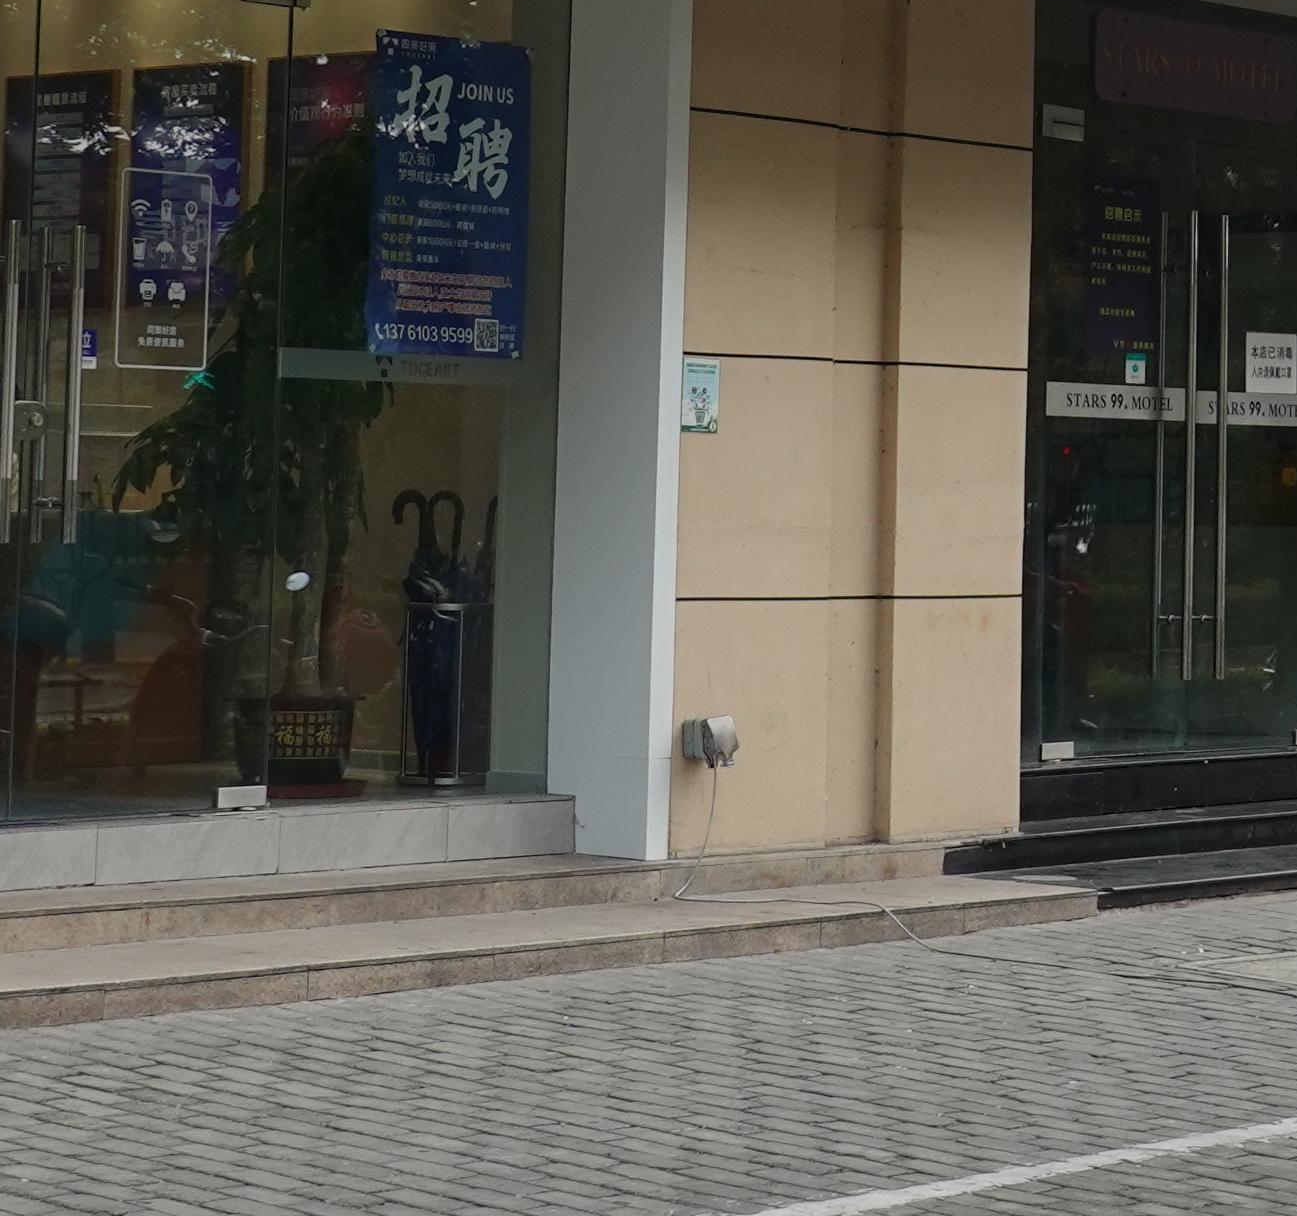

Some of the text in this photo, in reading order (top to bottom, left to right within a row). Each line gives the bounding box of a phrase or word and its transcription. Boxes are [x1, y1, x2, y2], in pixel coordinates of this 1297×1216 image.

[457, 83, 514, 105] JOIN US
[384, 324, 473, 344] 137 6103 9599
[1249, 345, 1294, 361] 本店已消毒
[1066, 391, 1107, 409] STARS
[1131, 396, 1174, 412] MOTEL
[1208, 400, 1246, 417] SARS
